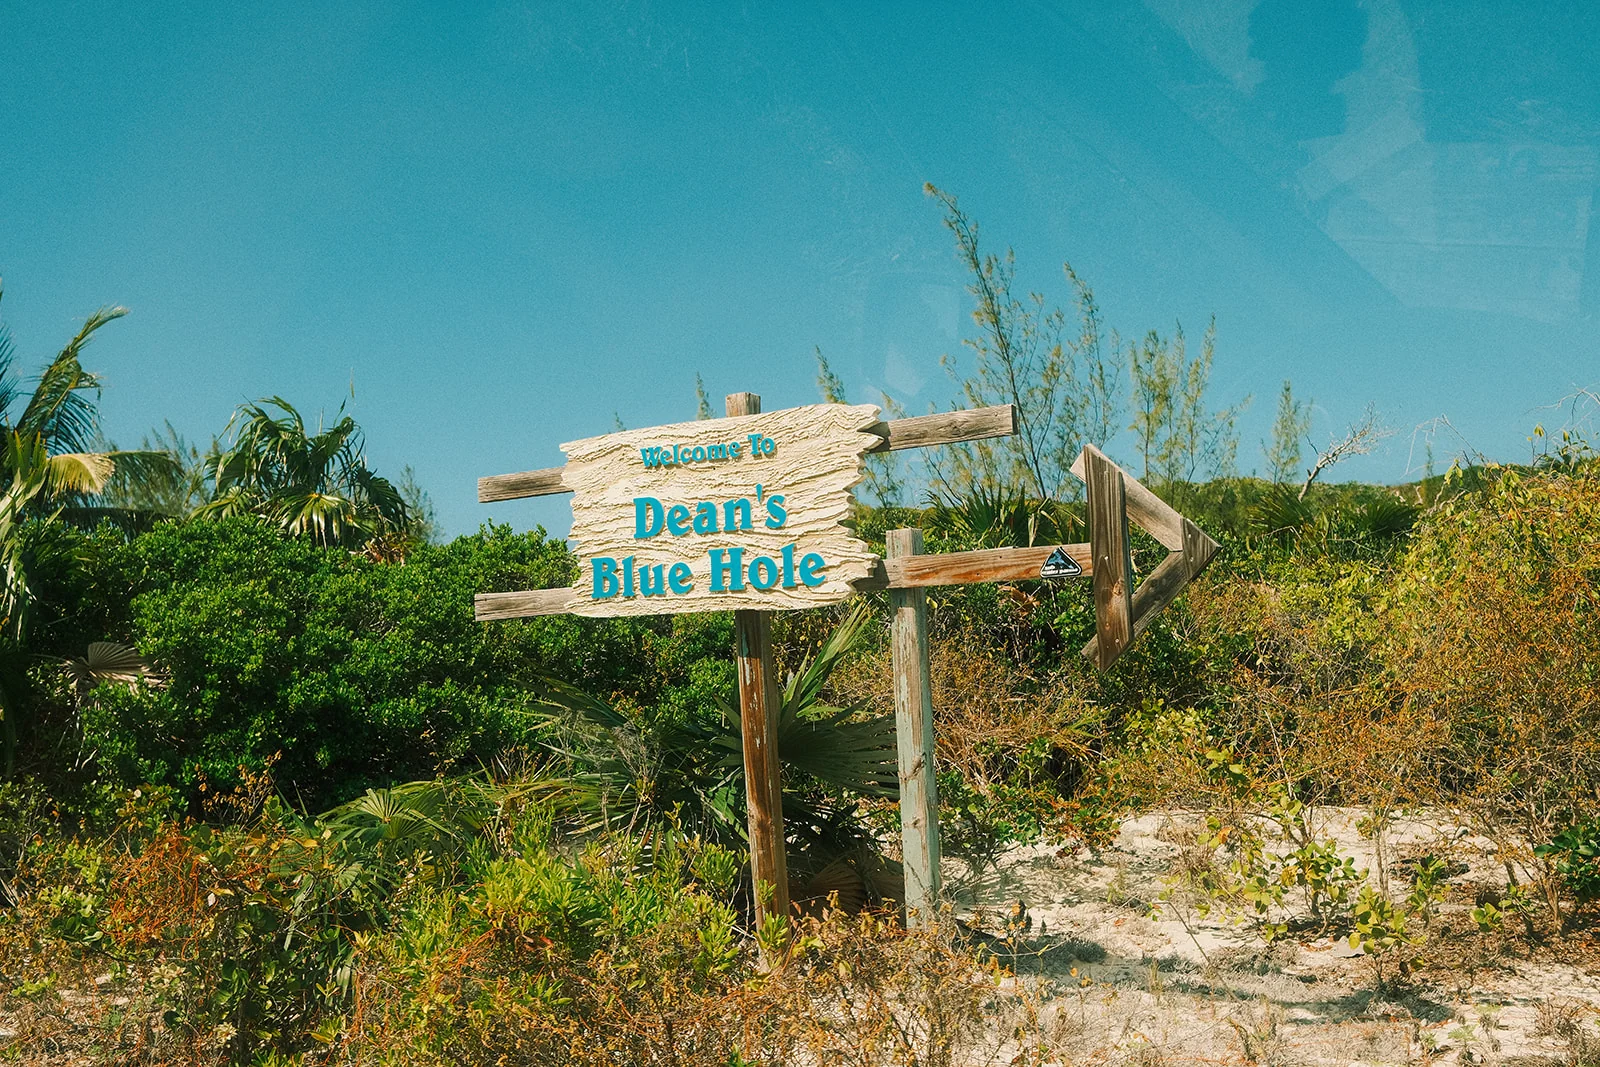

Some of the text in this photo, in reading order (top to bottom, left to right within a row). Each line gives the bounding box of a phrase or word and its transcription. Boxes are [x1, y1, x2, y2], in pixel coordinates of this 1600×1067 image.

[641, 434, 774, 466] Welcome To
[634, 484, 786, 538] Dean's
[591, 544, 825, 598] Blue Hole
